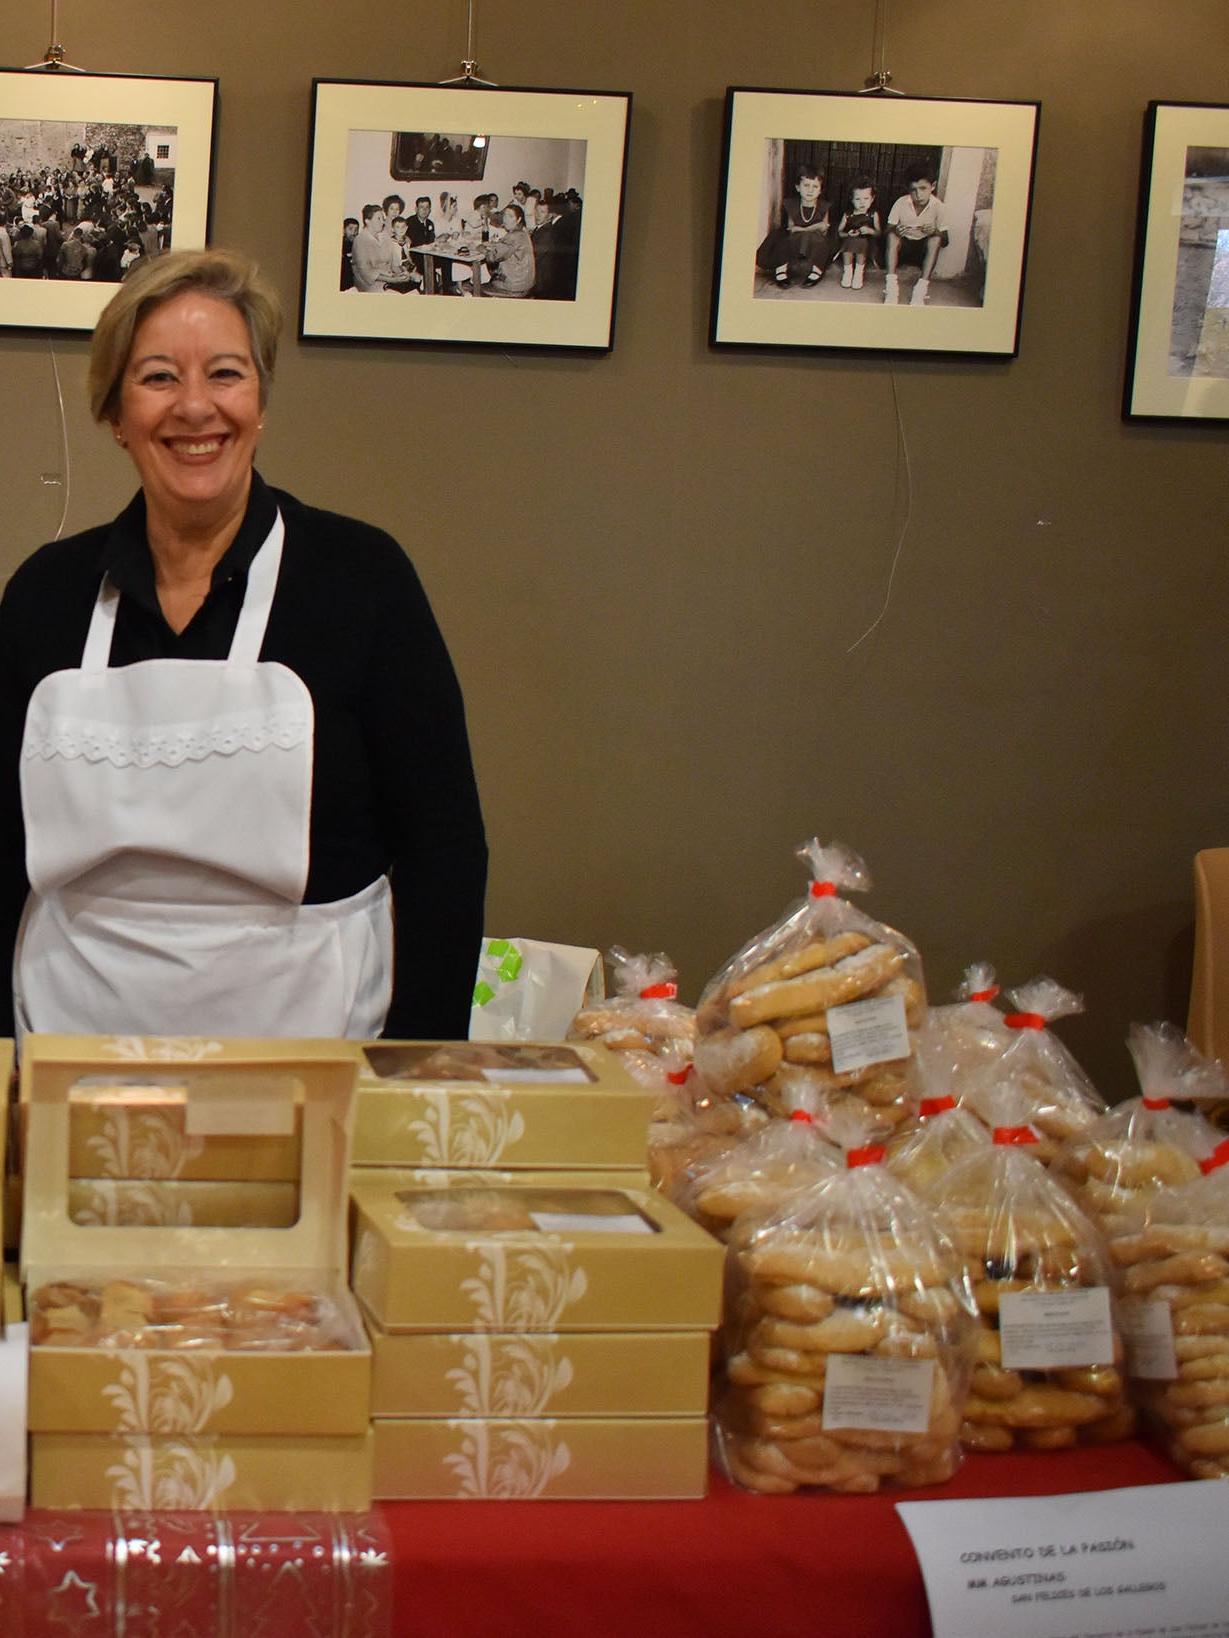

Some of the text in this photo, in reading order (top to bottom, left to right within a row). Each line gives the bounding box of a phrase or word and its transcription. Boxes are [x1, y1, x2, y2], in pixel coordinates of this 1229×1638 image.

[960, 1547, 1034, 1563] CONVENTO
[1037, 1544, 1056, 1558] DE
[1060, 1544, 1077, 1556] LA
